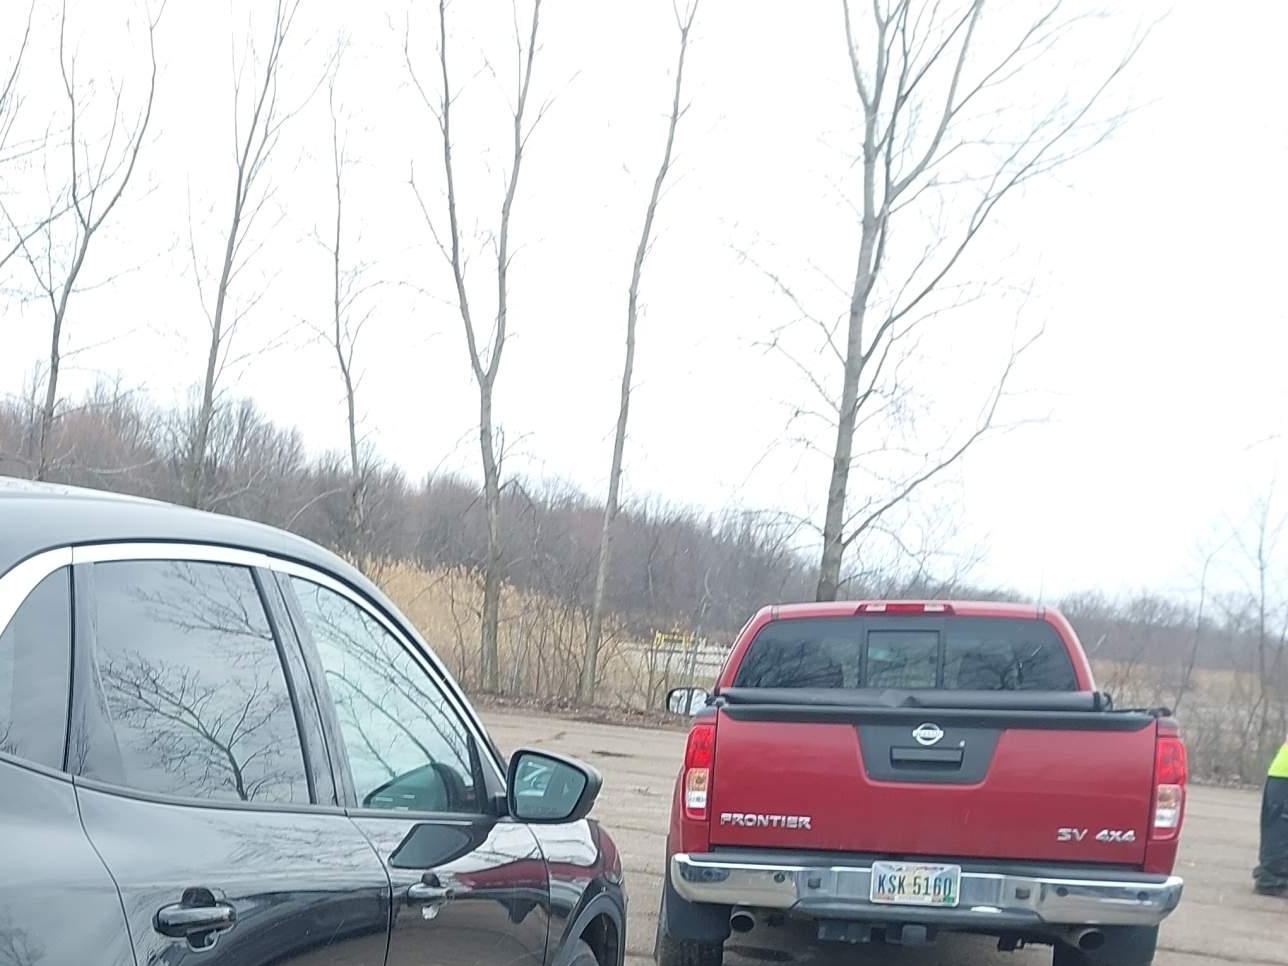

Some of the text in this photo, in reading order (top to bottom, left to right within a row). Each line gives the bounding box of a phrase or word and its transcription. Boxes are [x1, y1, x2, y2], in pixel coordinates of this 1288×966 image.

[720, 812, 812, 831] FRONTIER
[1056, 827, 1089, 842] SV
[877, 873, 953, 898] KSK 5160
